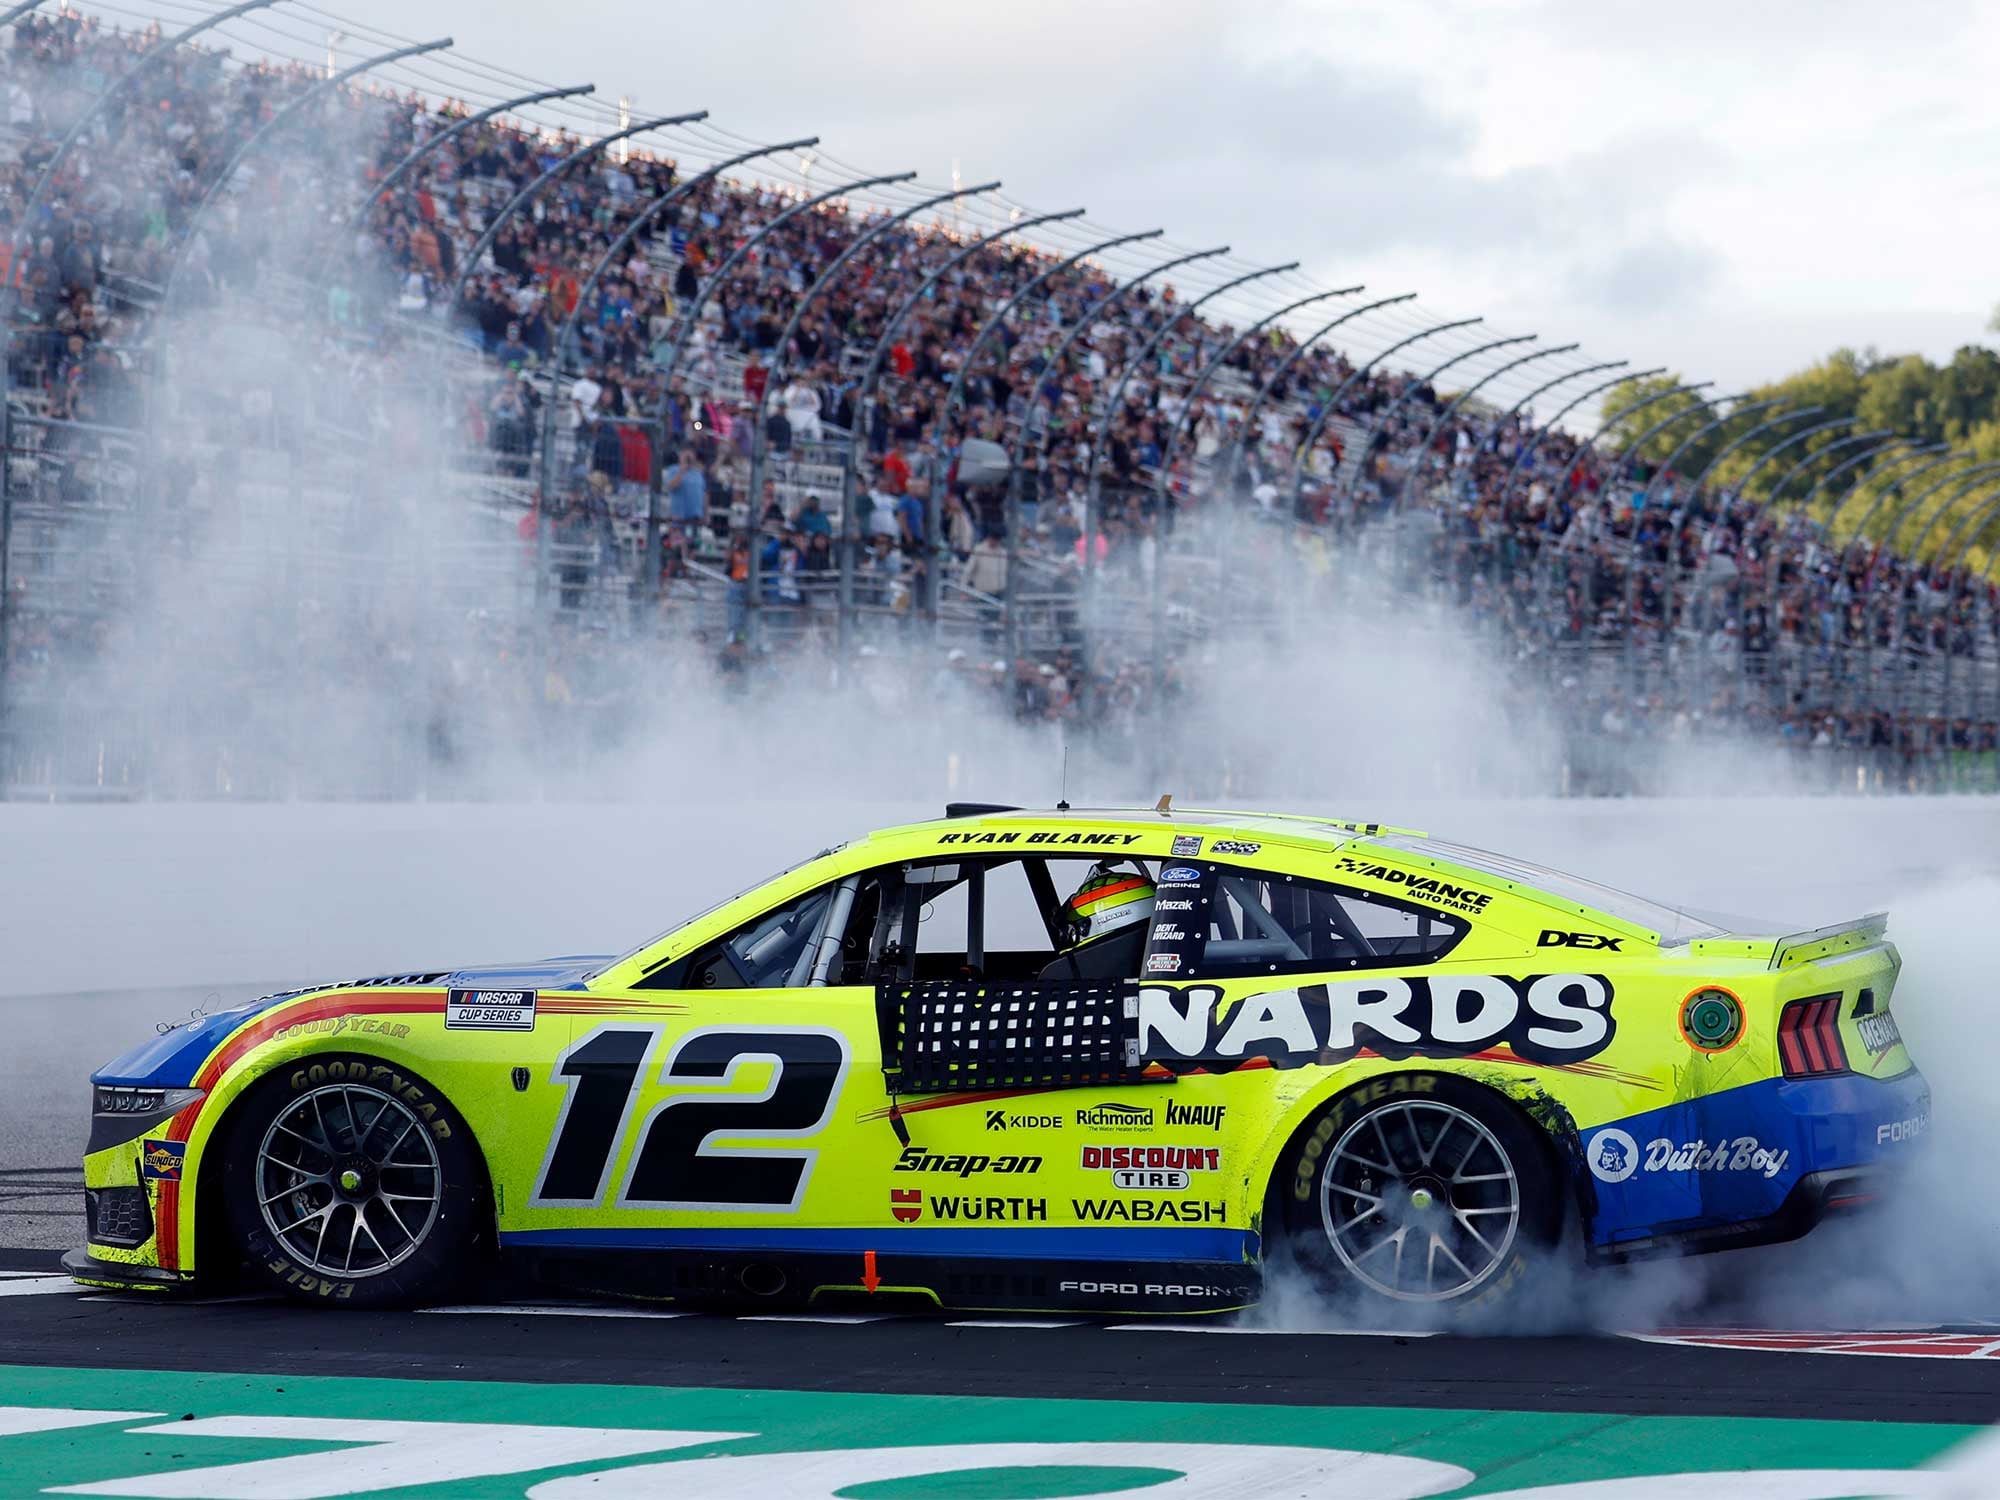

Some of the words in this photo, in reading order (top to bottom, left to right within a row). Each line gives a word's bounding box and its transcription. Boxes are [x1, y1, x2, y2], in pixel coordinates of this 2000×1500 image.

[937, 832, 1021, 844] RYAN
[1025, 833, 1143, 845] BLANEY
[1166, 870, 1193, 879] Ford
[1364, 865, 1493, 908] ADVANCE
[1155, 900, 1193, 911] Mazak
[1407, 889, 1441, 903] AUTO
[1443, 899, 1483, 915] PARTS
[1152, 932, 1185, 940] WIZARD
[1155, 924, 1177, 932] DENT
[1536, 930, 1624, 952] DEX
[475, 992, 523, 1005] NASCAR
[458, 1009, 481, 1020] CUP
[483, 1010, 522, 1021] SERIES
[1139, 973, 1609, 1056] NARDS
[272, 1014, 411, 1041] GOODYEAR
[291, 1061, 452, 1140] GOODYEAR
[528, 1022, 851, 1212] 12
[1010, 1116, 1063, 1128] KIDDE
[1076, 1108, 1154, 1125] Richmond
[1877, 1117, 1920, 1145] FORD
[145, 1154, 182, 1168] SUNOCO
[894, 1147, 1043, 1178] Snap-on
[1082, 1146, 1220, 1171] DISCOUNT
[1644, 1138, 1730, 1171] Dutch
[1729, 1136, 1789, 1179] Boy
[1120, 1173, 1180, 1186] TIRE
[930, 1196, 1047, 1220] WÜRTH
[1072, 1200, 1226, 1222] WABASH
[267, 1256, 356, 1299] EAGLE
[1060, 1281, 1138, 1294] FORD
